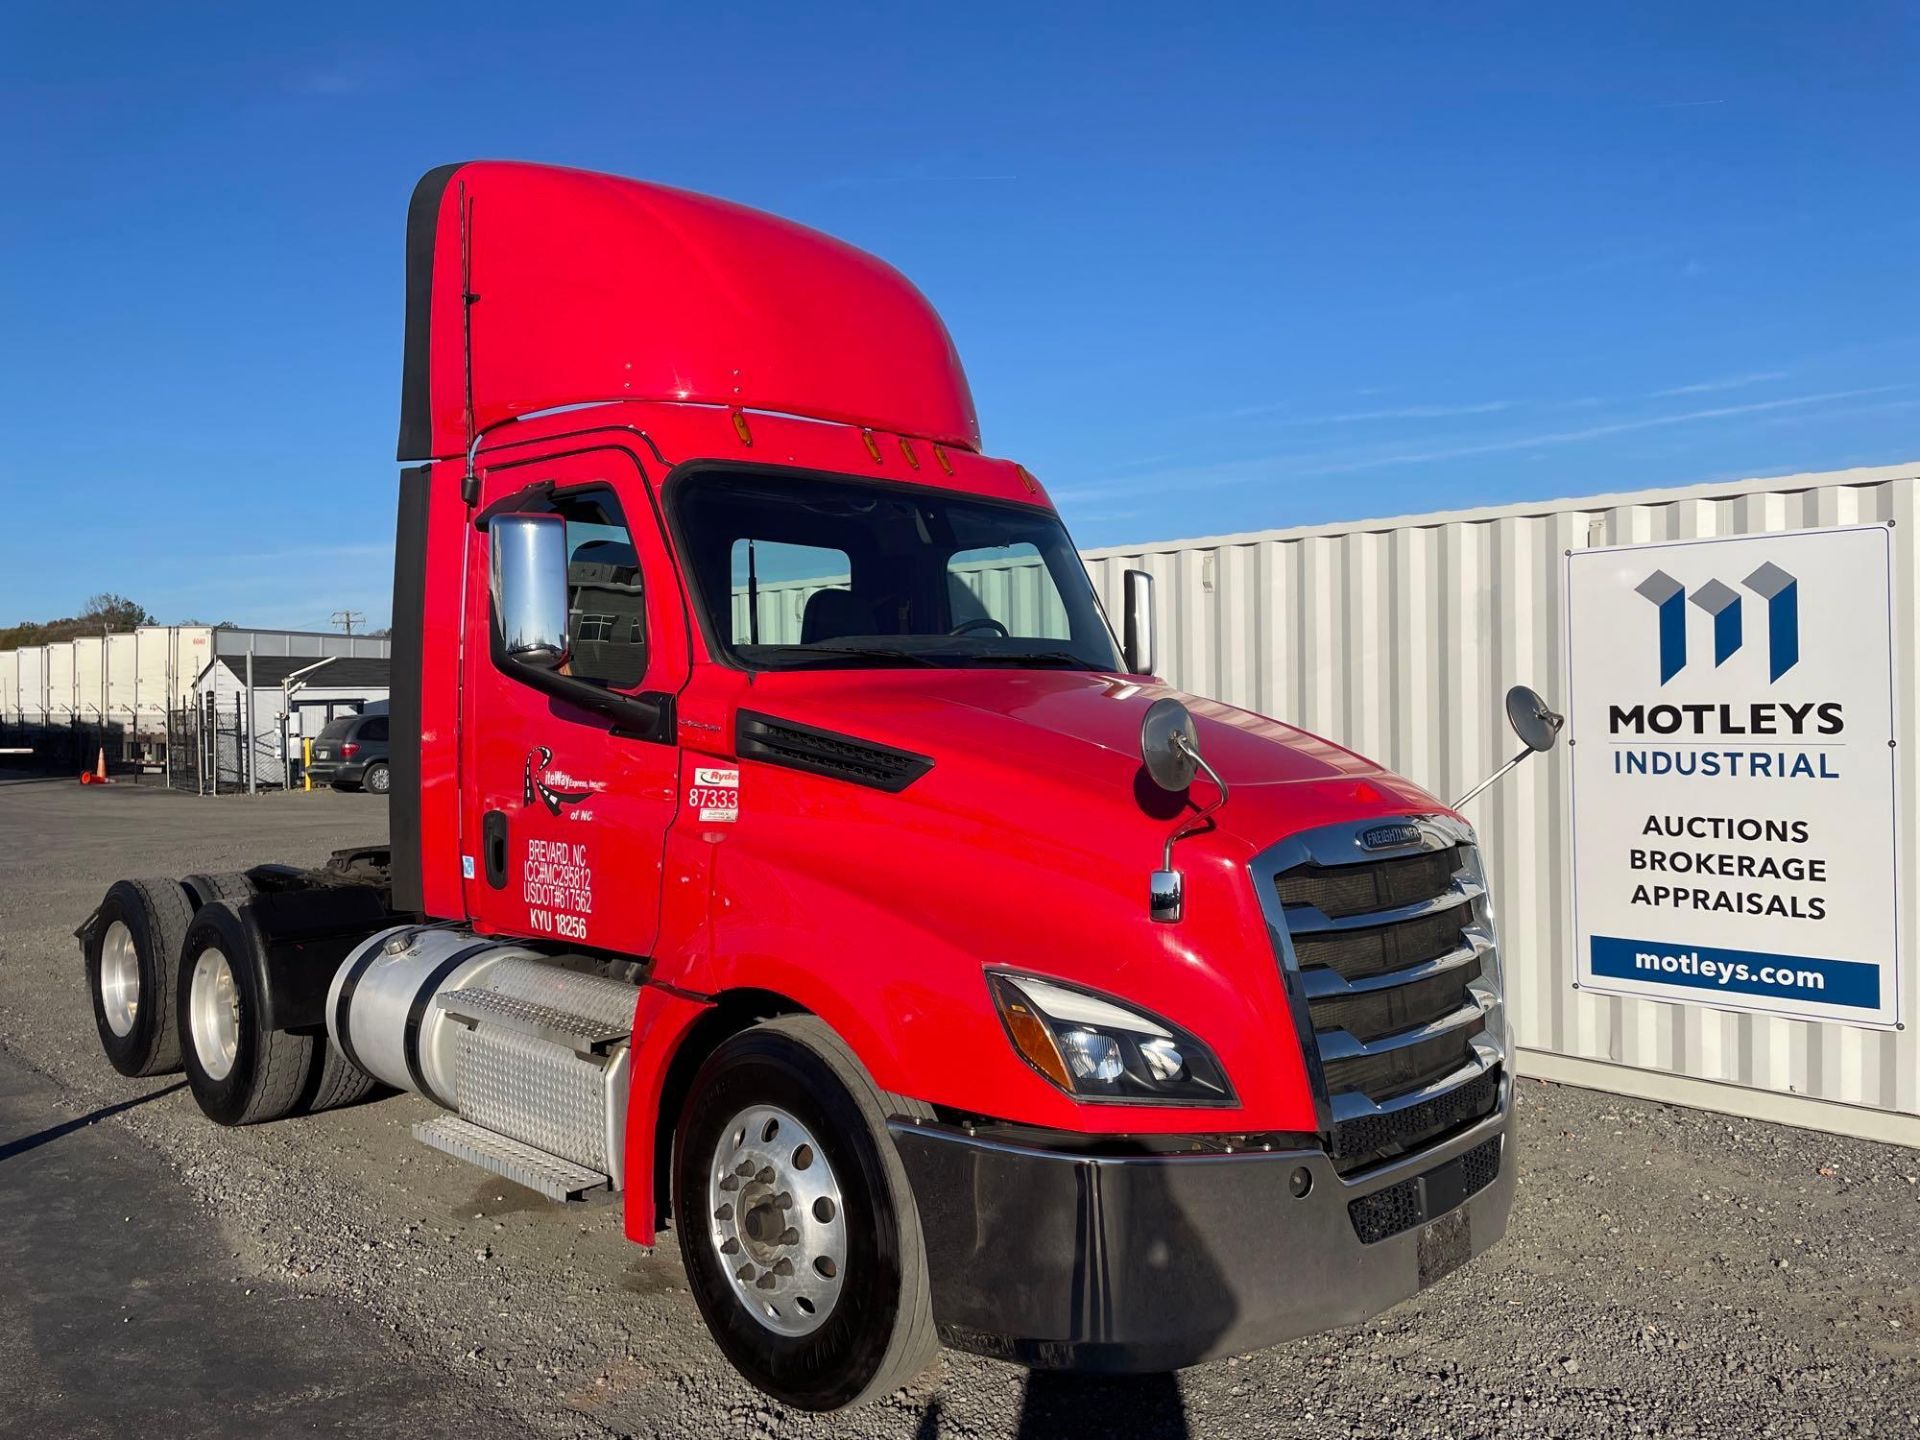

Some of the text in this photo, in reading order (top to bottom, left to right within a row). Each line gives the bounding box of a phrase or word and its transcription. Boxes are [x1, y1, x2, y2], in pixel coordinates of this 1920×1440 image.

[1609, 702, 1845, 735] MOTLEYS
[710, 771, 738, 784] Ryde
[1615, 750, 1840, 779] INDUSTRIAL
[689, 788, 738, 809] 87333
[570, 810, 593, 821] of NC
[1642, 815, 1809, 844] AUCTIONS
[1366, 827, 1420, 846] FREIGHTLINER
[528, 839, 586, 867] BREVARD, NC
[1630, 848, 1827, 883] BROKERAGE
[1630, 884, 1827, 920] APPRAISALS
[530, 908, 587, 939] KYU 18256
[1635, 952, 1825, 989] motleys.com
